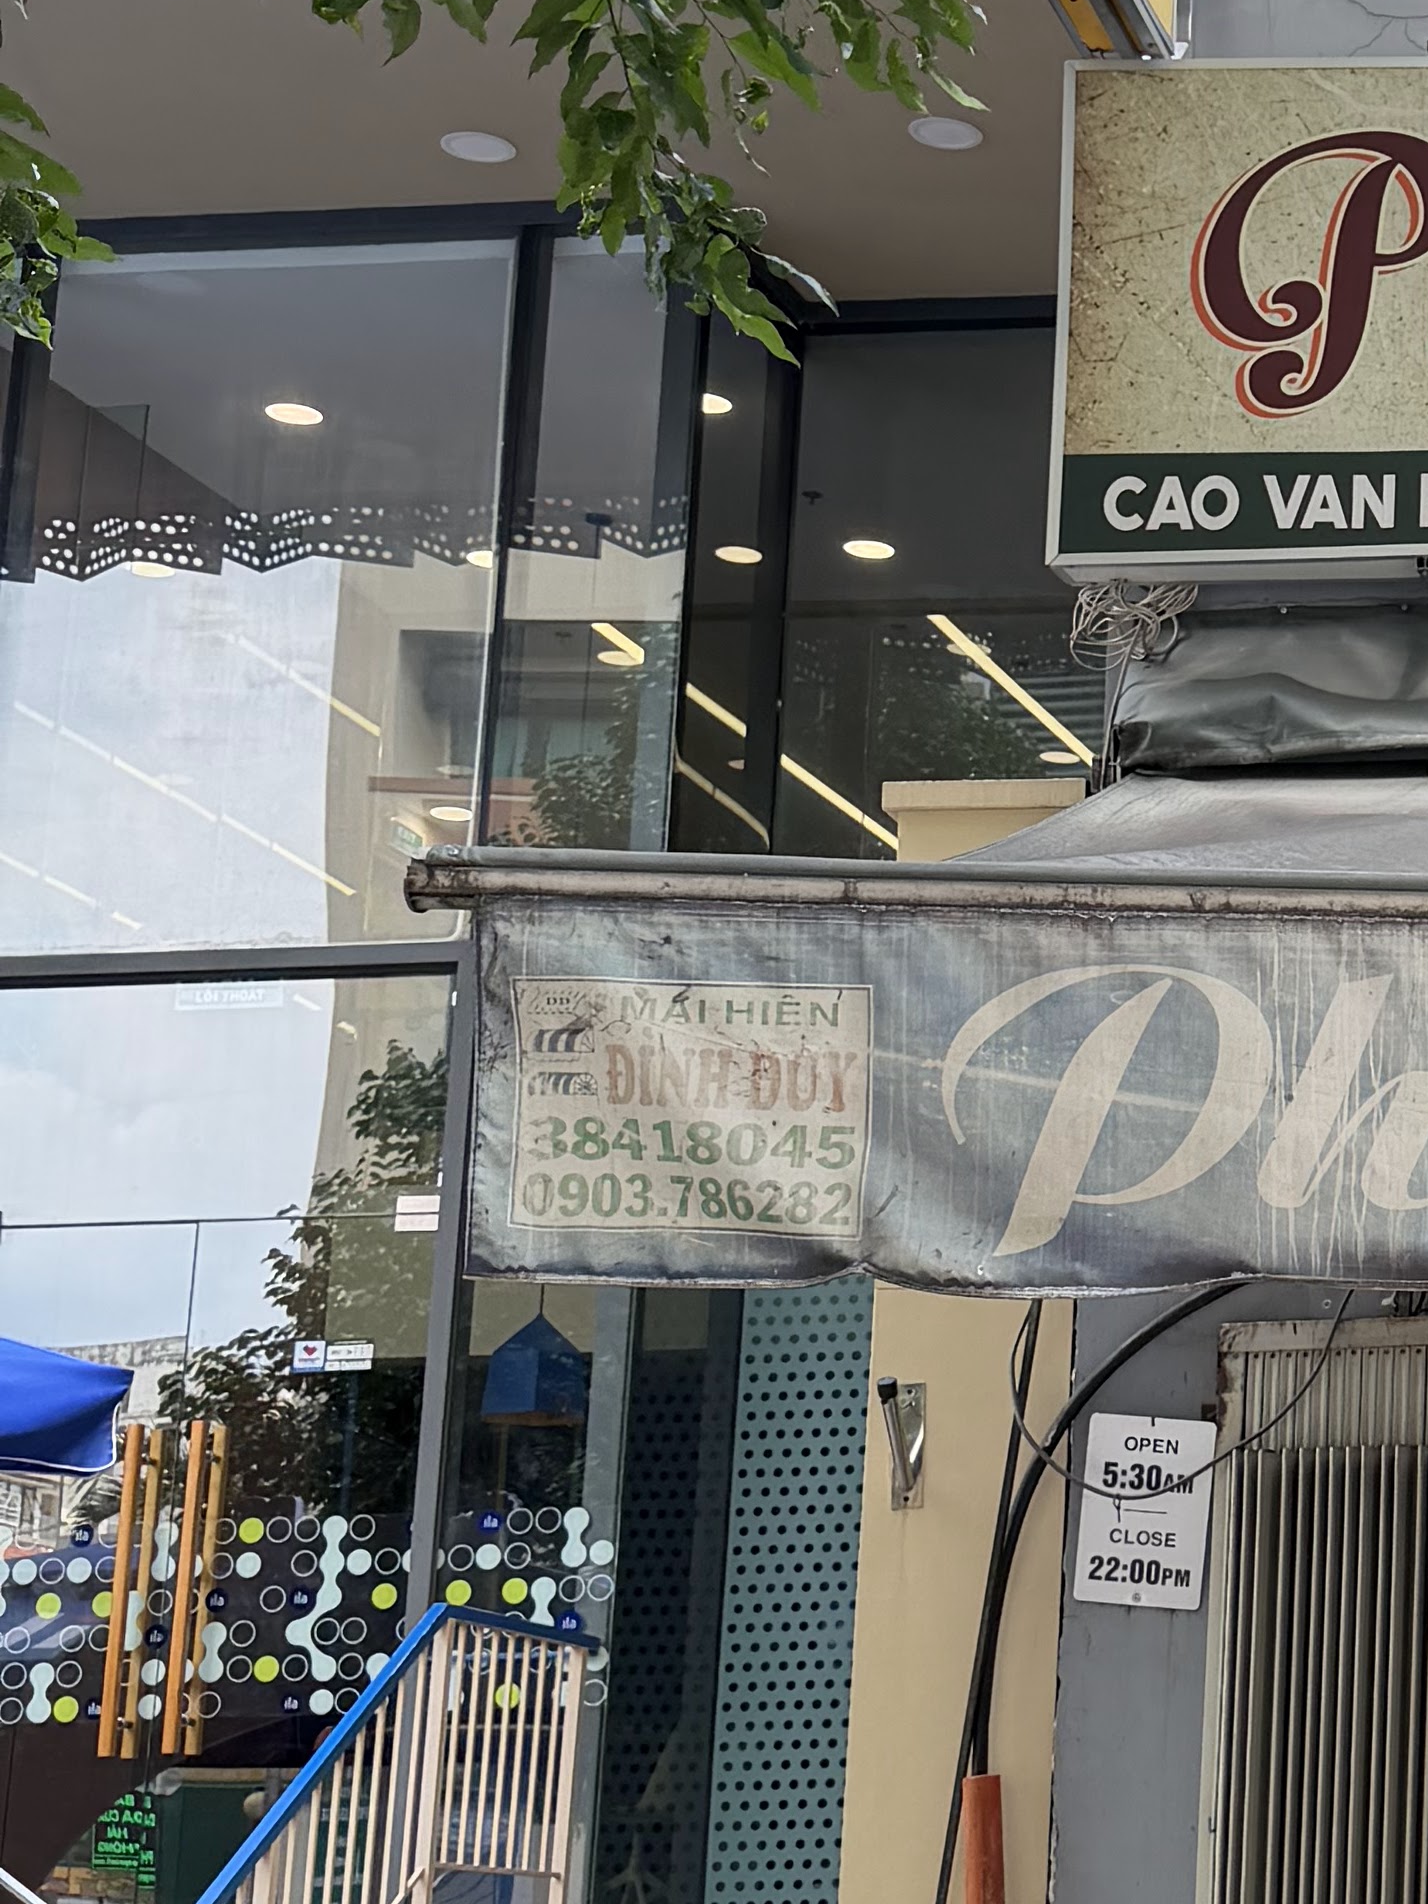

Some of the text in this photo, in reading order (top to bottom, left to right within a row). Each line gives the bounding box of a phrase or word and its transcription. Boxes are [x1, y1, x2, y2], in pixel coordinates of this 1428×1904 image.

[1102, 474, 1241, 533] CAO
[1263, 472, 1397, 531] VAN
[526, 1115, 857, 1171] 38418045
[1124, 1436, 1180, 1455] OPEN
[1109, 1528, 1177, 1548] CLOSE
